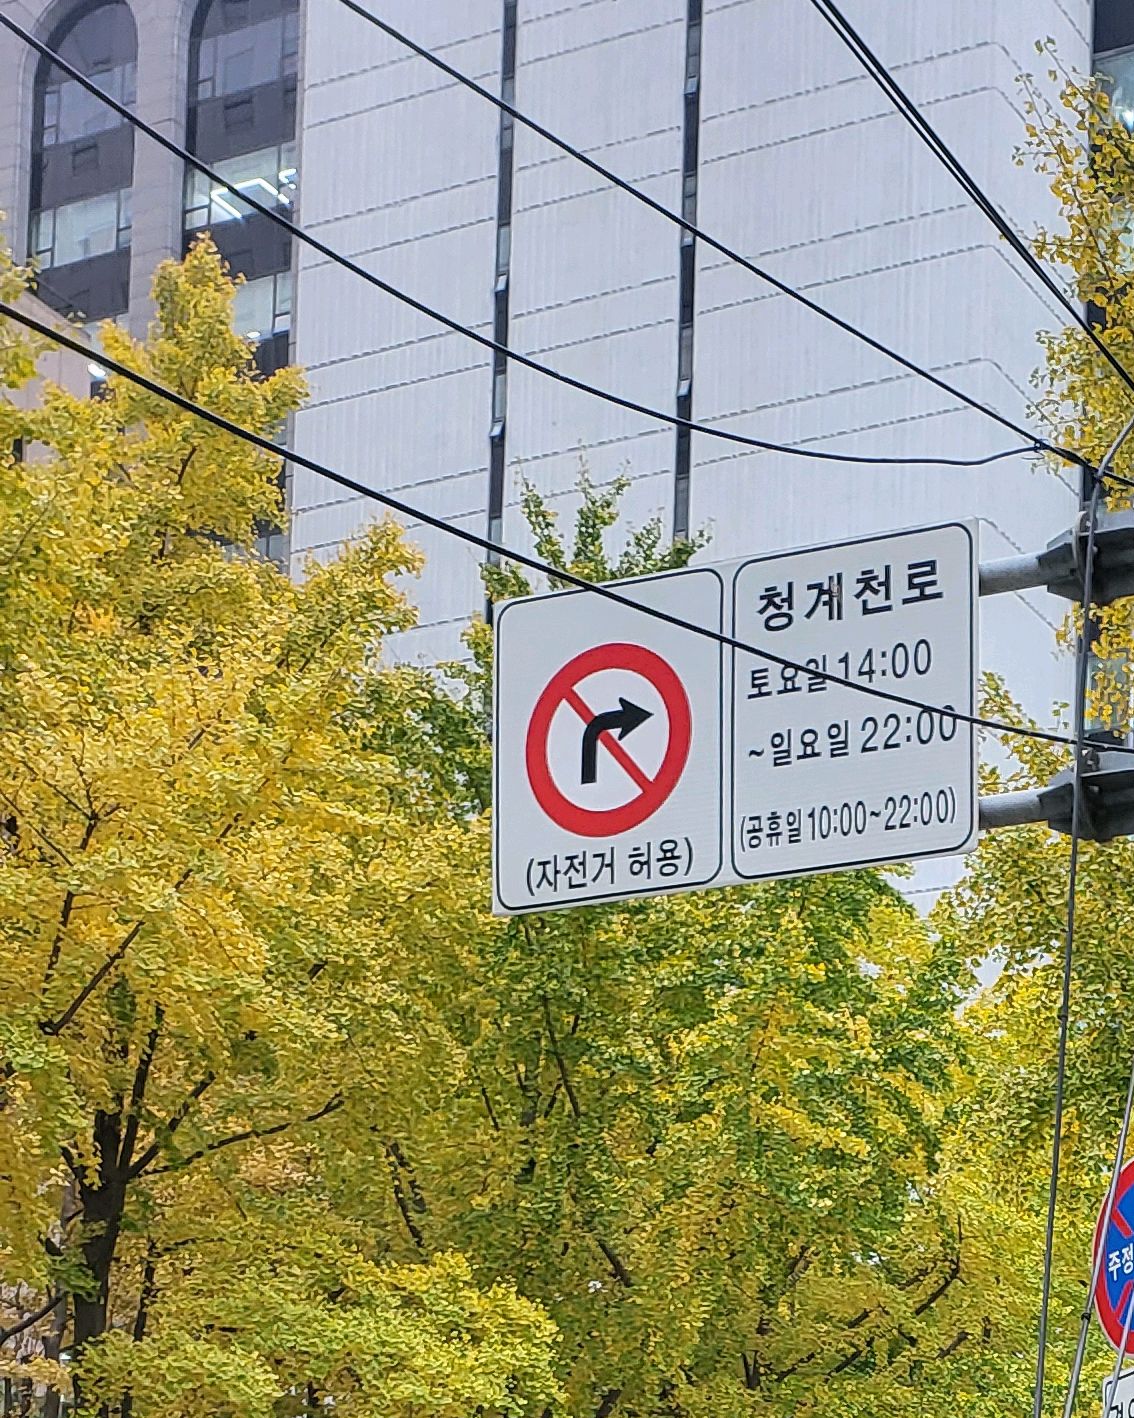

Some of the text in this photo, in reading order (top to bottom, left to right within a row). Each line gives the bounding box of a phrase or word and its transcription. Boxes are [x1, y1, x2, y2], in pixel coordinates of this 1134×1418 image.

[756, 559, 944, 632] 청계천로
[747, 638, 932, 700] 토요일 14:00
[861, 704, 958, 754] 22:00
[526, 837, 694, 896] (자전거 허용)
